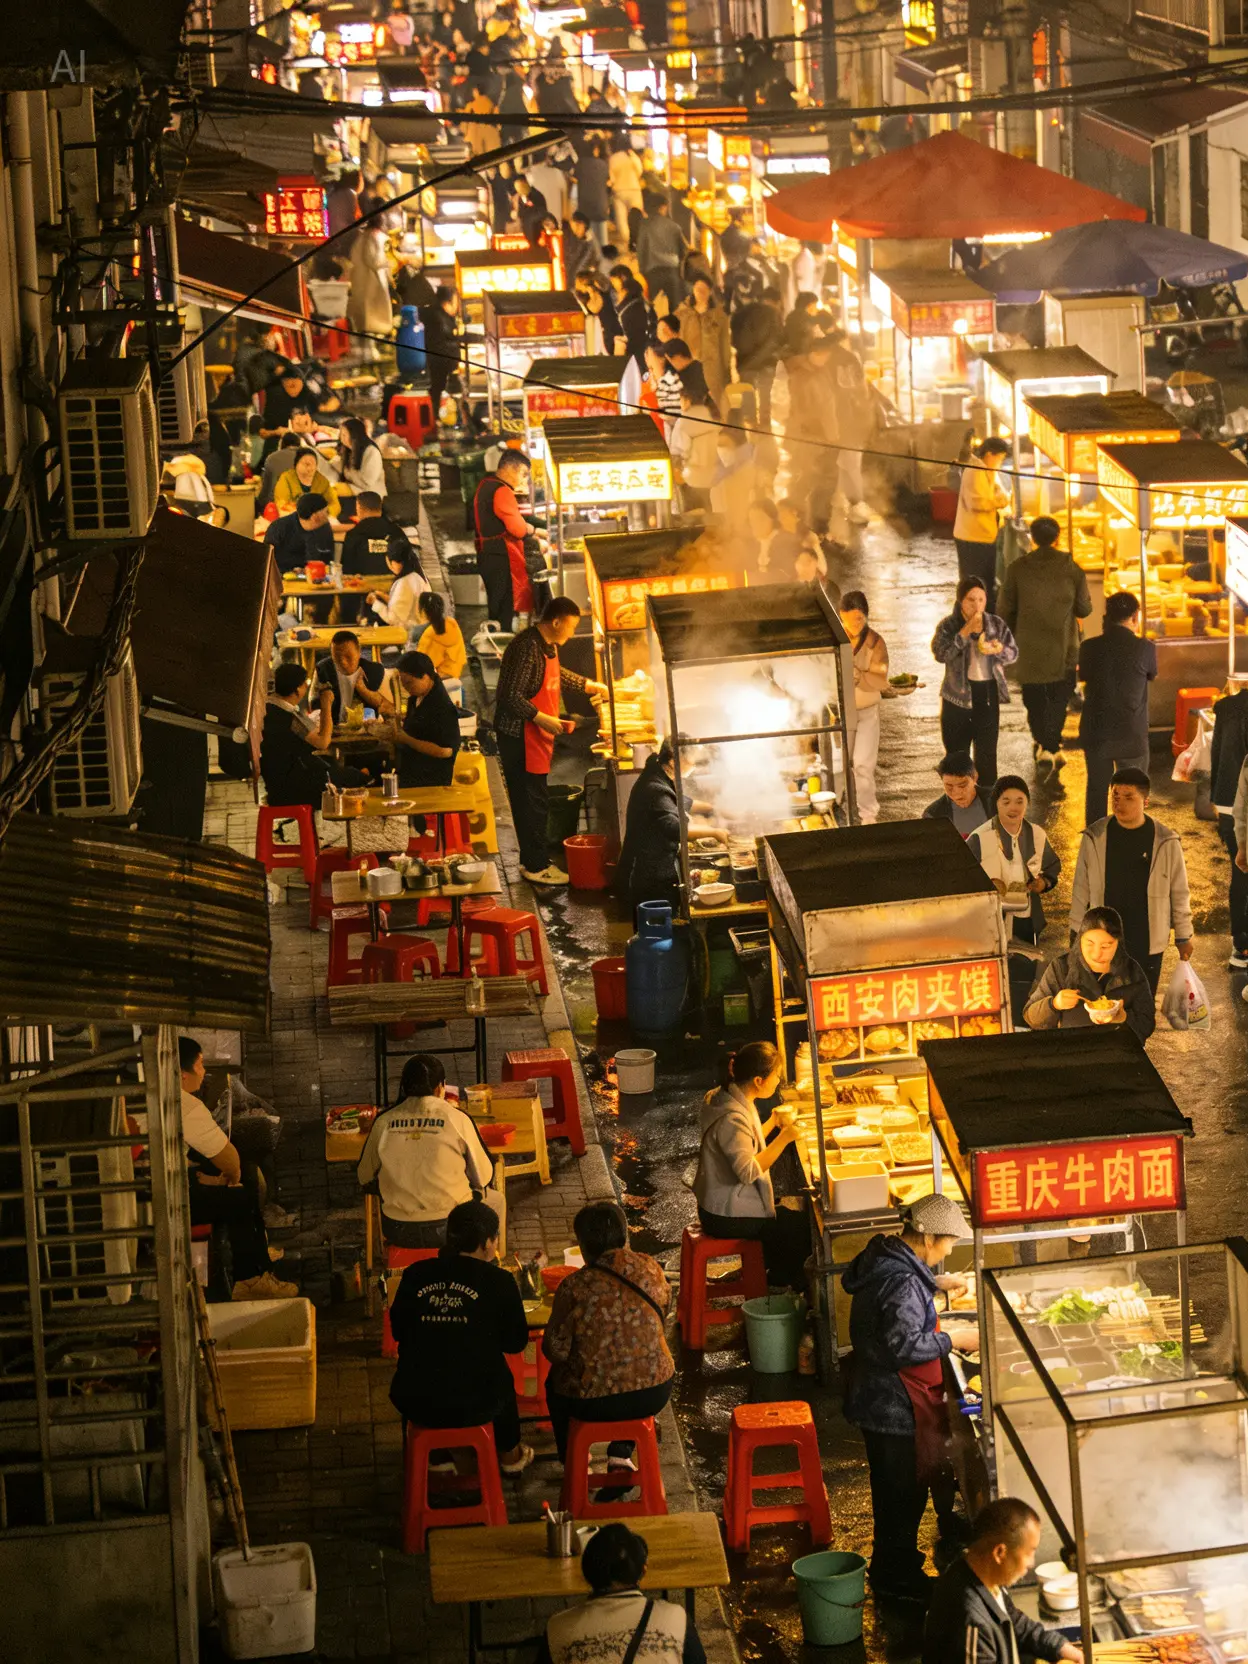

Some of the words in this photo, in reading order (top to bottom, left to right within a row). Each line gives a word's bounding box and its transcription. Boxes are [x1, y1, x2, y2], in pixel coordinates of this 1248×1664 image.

[820, 965, 993, 1026] 西安肉夹馍
[985, 1146, 1173, 1214] 重庆牛肉面
